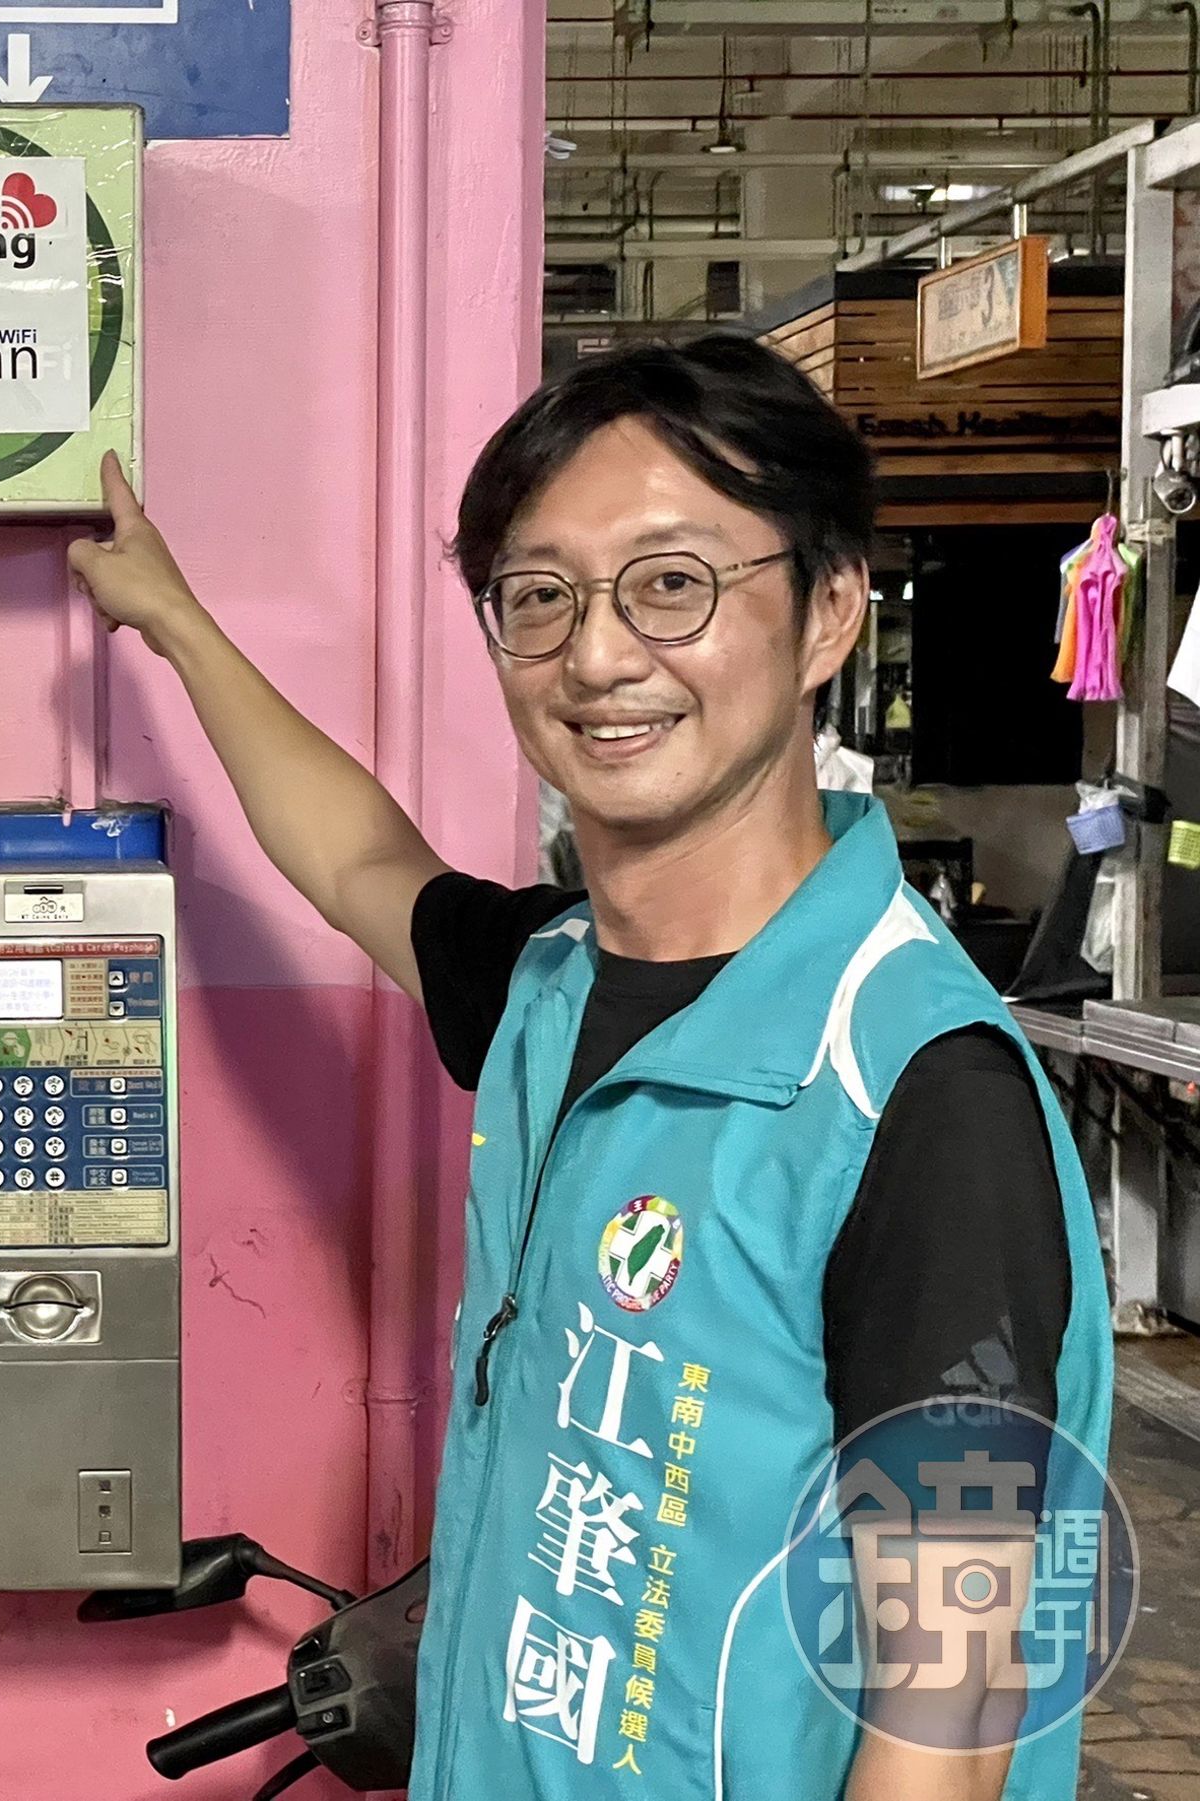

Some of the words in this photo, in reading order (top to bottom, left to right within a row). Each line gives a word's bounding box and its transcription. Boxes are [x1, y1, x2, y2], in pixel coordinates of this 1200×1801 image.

[502, 1301, 665, 1766] 江肇國
[656, 1362, 712, 1527] 東南中西區
[612, 1544, 678, 1776] 立法委員候選人
